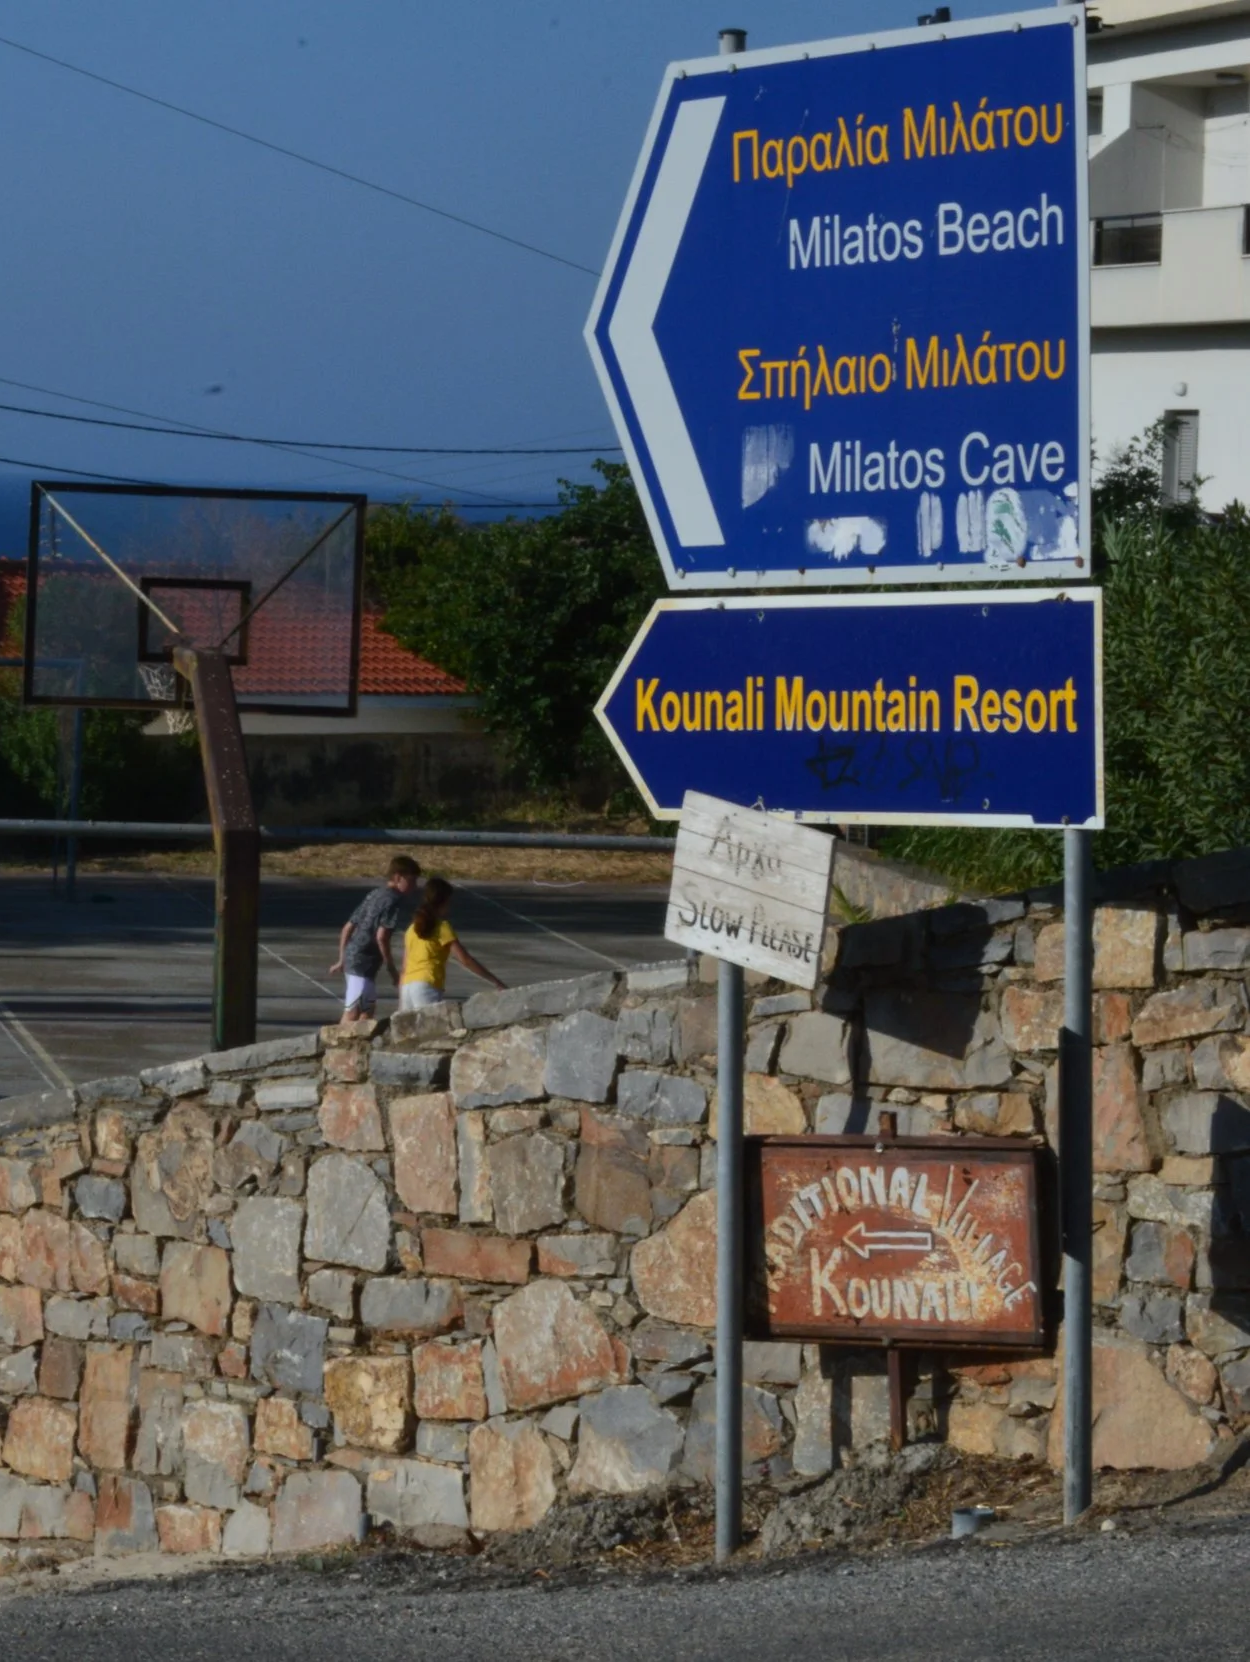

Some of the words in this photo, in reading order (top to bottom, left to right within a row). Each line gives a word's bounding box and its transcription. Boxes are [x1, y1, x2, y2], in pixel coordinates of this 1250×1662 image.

[733, 114, 889, 188] Παραλία
[903, 97, 1063, 160] Μιλάτου
[789, 213, 923, 270] Milatos
[937, 193, 1064, 255] Beach
[737, 345, 890, 410] Σπήλαιο
[906, 331, 1065, 390] Μιλάτου
[809, 440, 944, 494] Milatos
[960, 432, 1065, 486] Cave
[636, 676, 764, 732] Kounali
[775, 676, 940, 732] Mountain
[954, 675, 1078, 733] Resort
